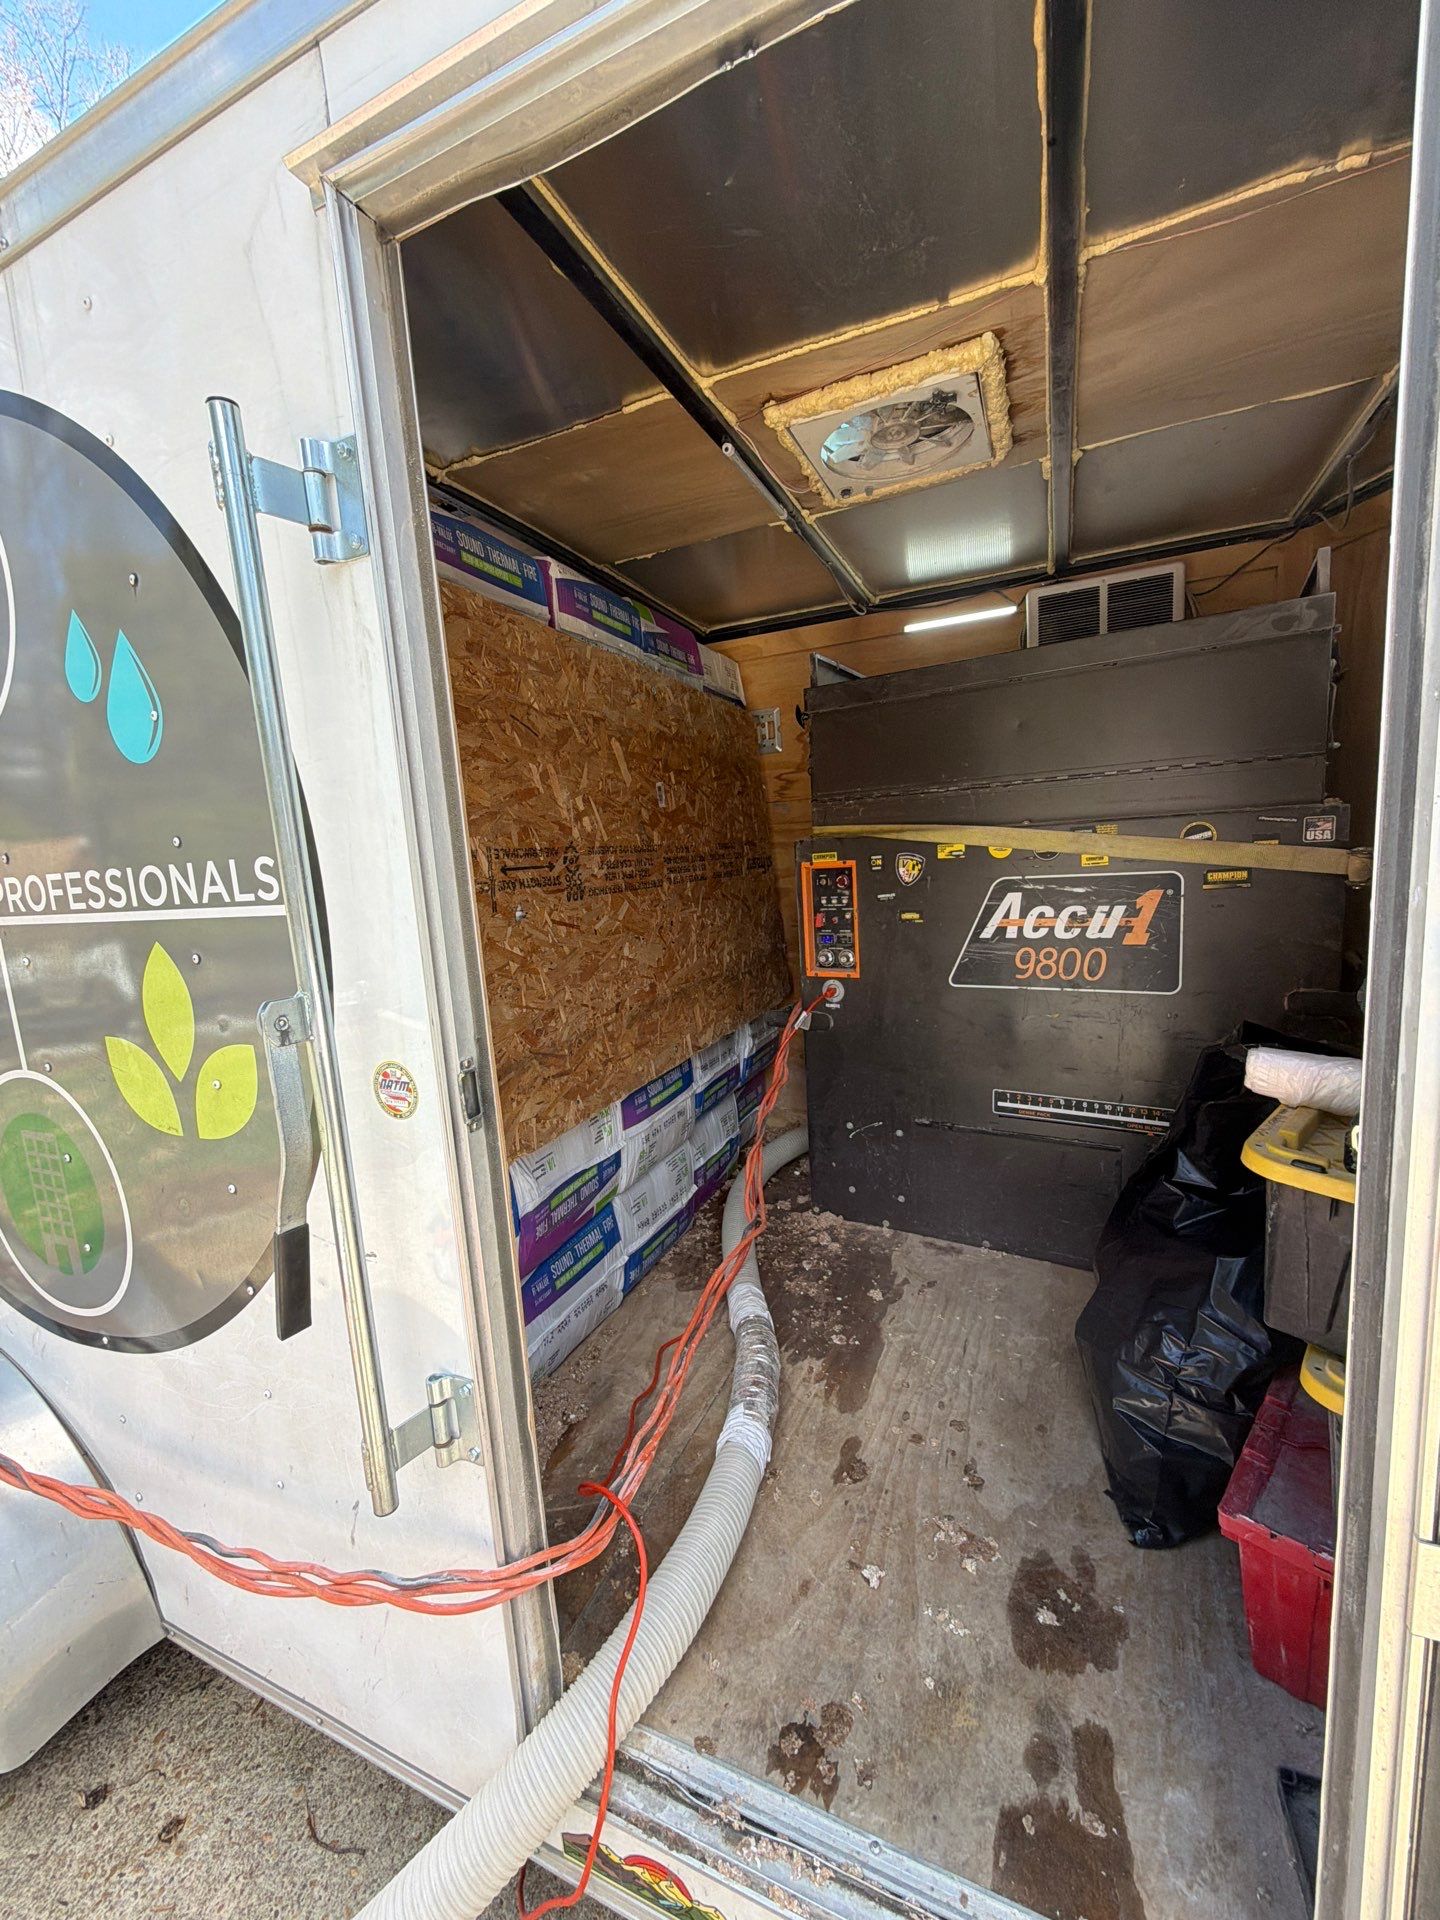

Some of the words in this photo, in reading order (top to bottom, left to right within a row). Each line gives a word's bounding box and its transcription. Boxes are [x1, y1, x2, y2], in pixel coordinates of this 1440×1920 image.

[456, 530, 485, 558] SOUND
[486, 545, 522, 576] THERMAL
[522, 562, 538, 582] FIRE
[1306, 829, 1332, 841] USA
[0, 855, 280, 913] ROFESSIONALS
[517, 875, 562, 890] STRENGTH
[1207, 870, 1248, 882] CHAMPION
[978, 888, 1165, 945] Accu1
[1014, 946, 1108, 982] 9800
[1126, 1122, 1144, 1130] OPEN
[580, 1176, 600, 1200] SOUND
[550, 1191, 578, 1227] THERMAL
[535, 1218, 549, 1240] FIRE
[550, 1250, 574, 1280] SOUND
[575, 1225, 604, 1258] THERMAL
[602, 1215, 614, 1234] FIRE
